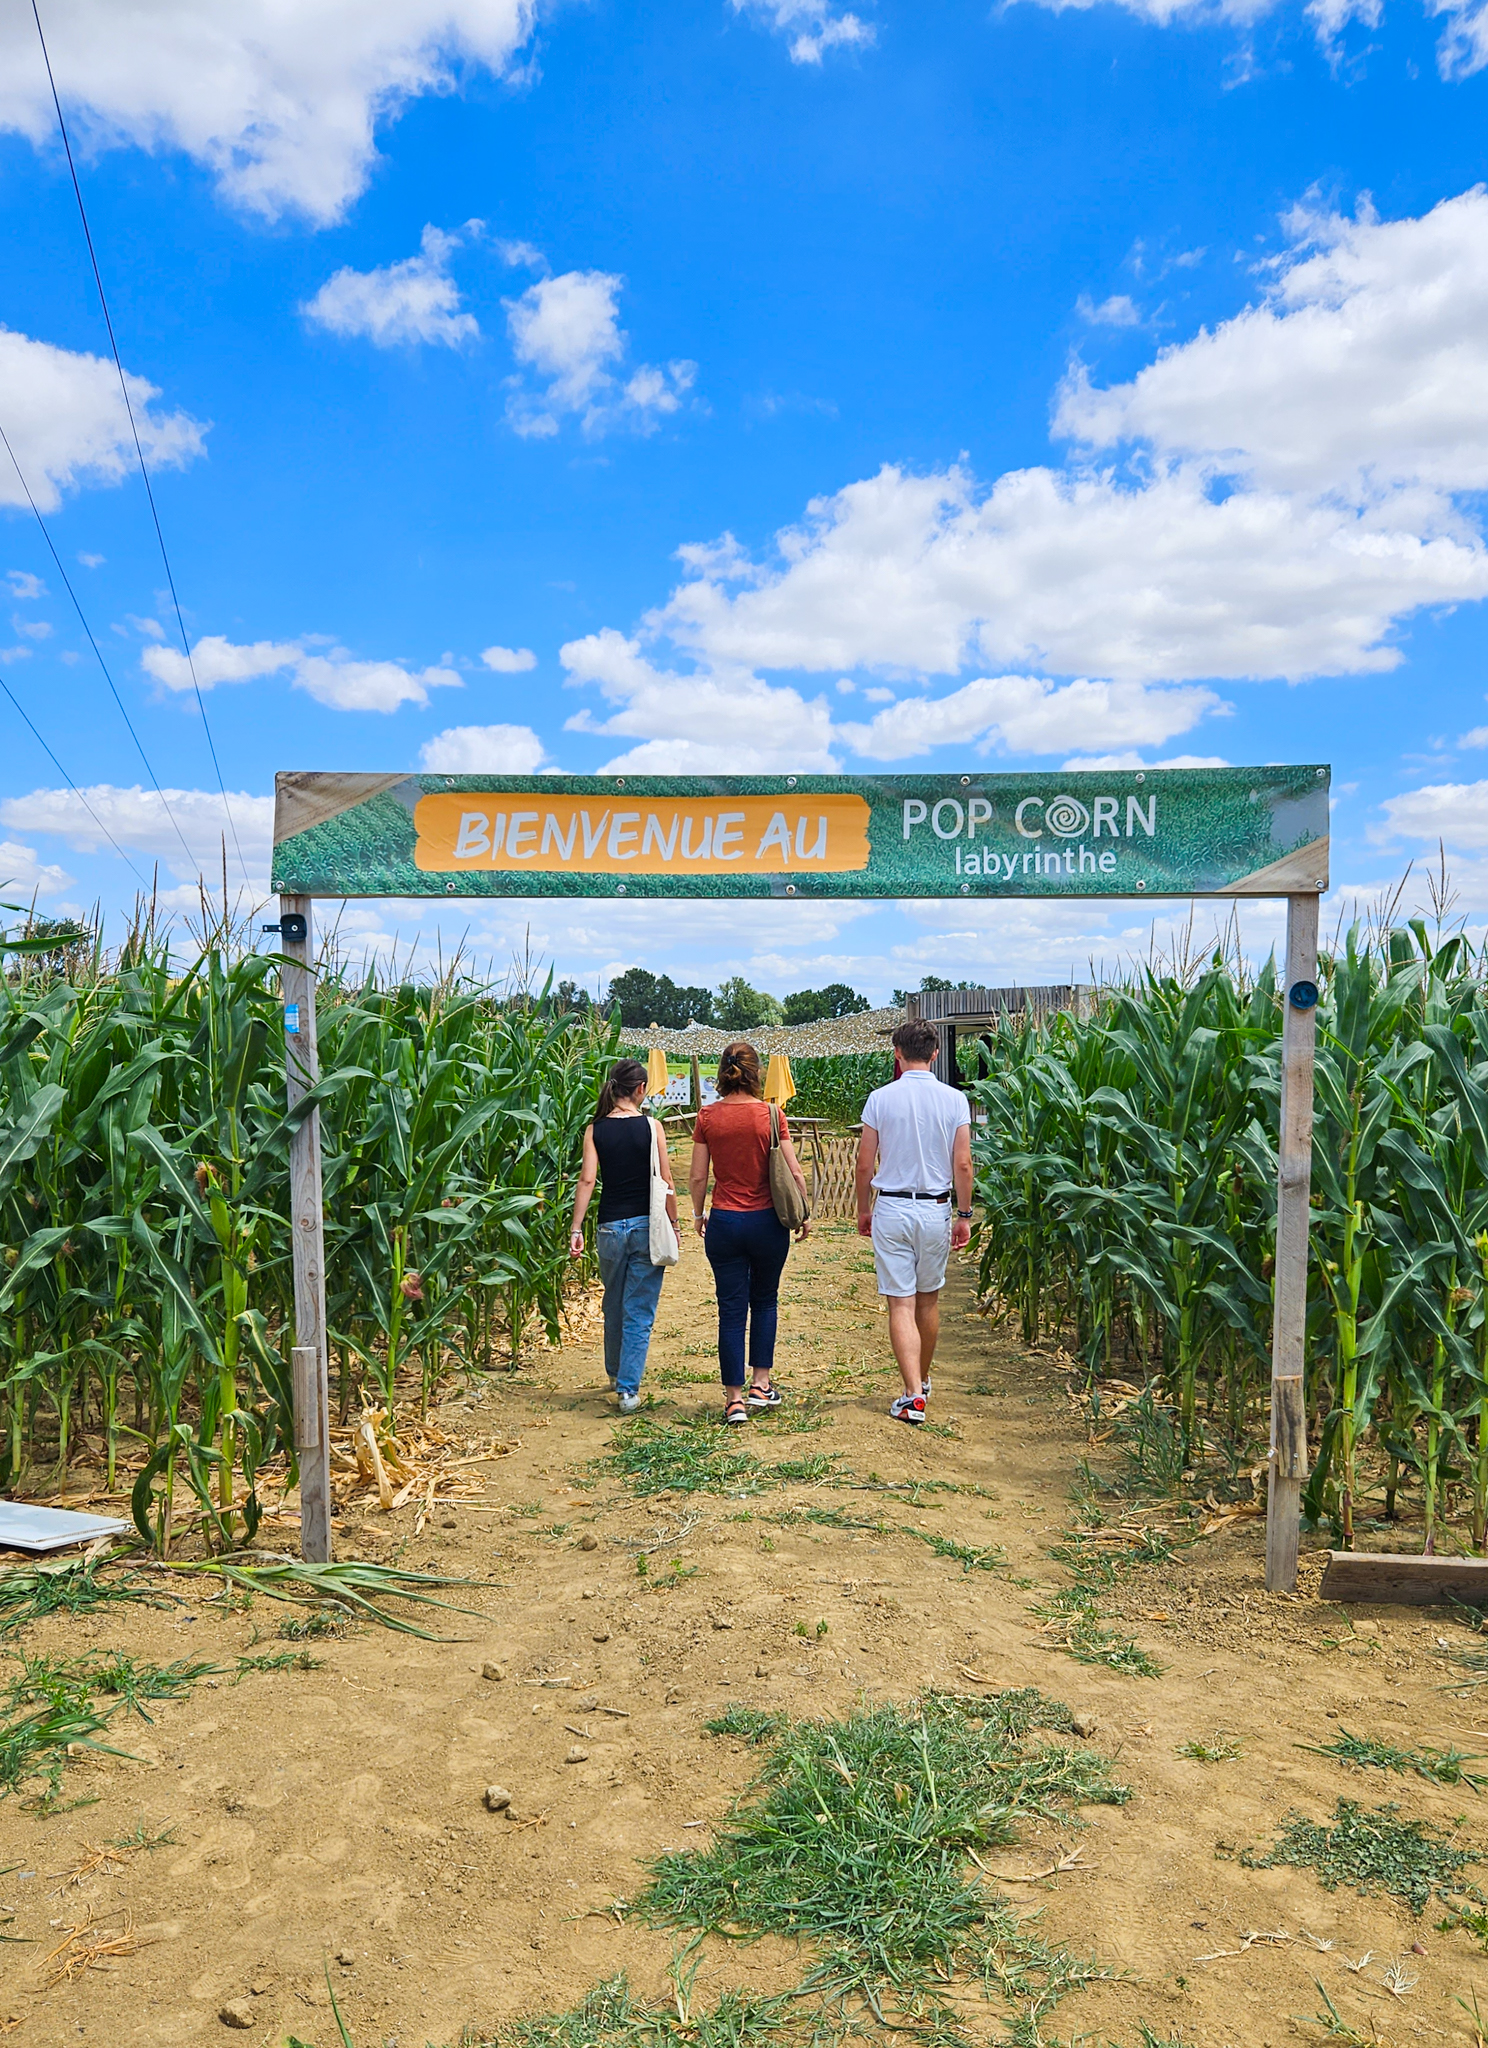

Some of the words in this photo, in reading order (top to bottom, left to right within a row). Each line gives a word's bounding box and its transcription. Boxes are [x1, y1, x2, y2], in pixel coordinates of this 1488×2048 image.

[453, 809, 746, 861] BIENVENUE
[755, 812, 828, 864] AU
[902, 799, 993, 840] POP
[1014, 795, 1157, 838] CORN
[955, 845, 1116, 881] labyrinthe
